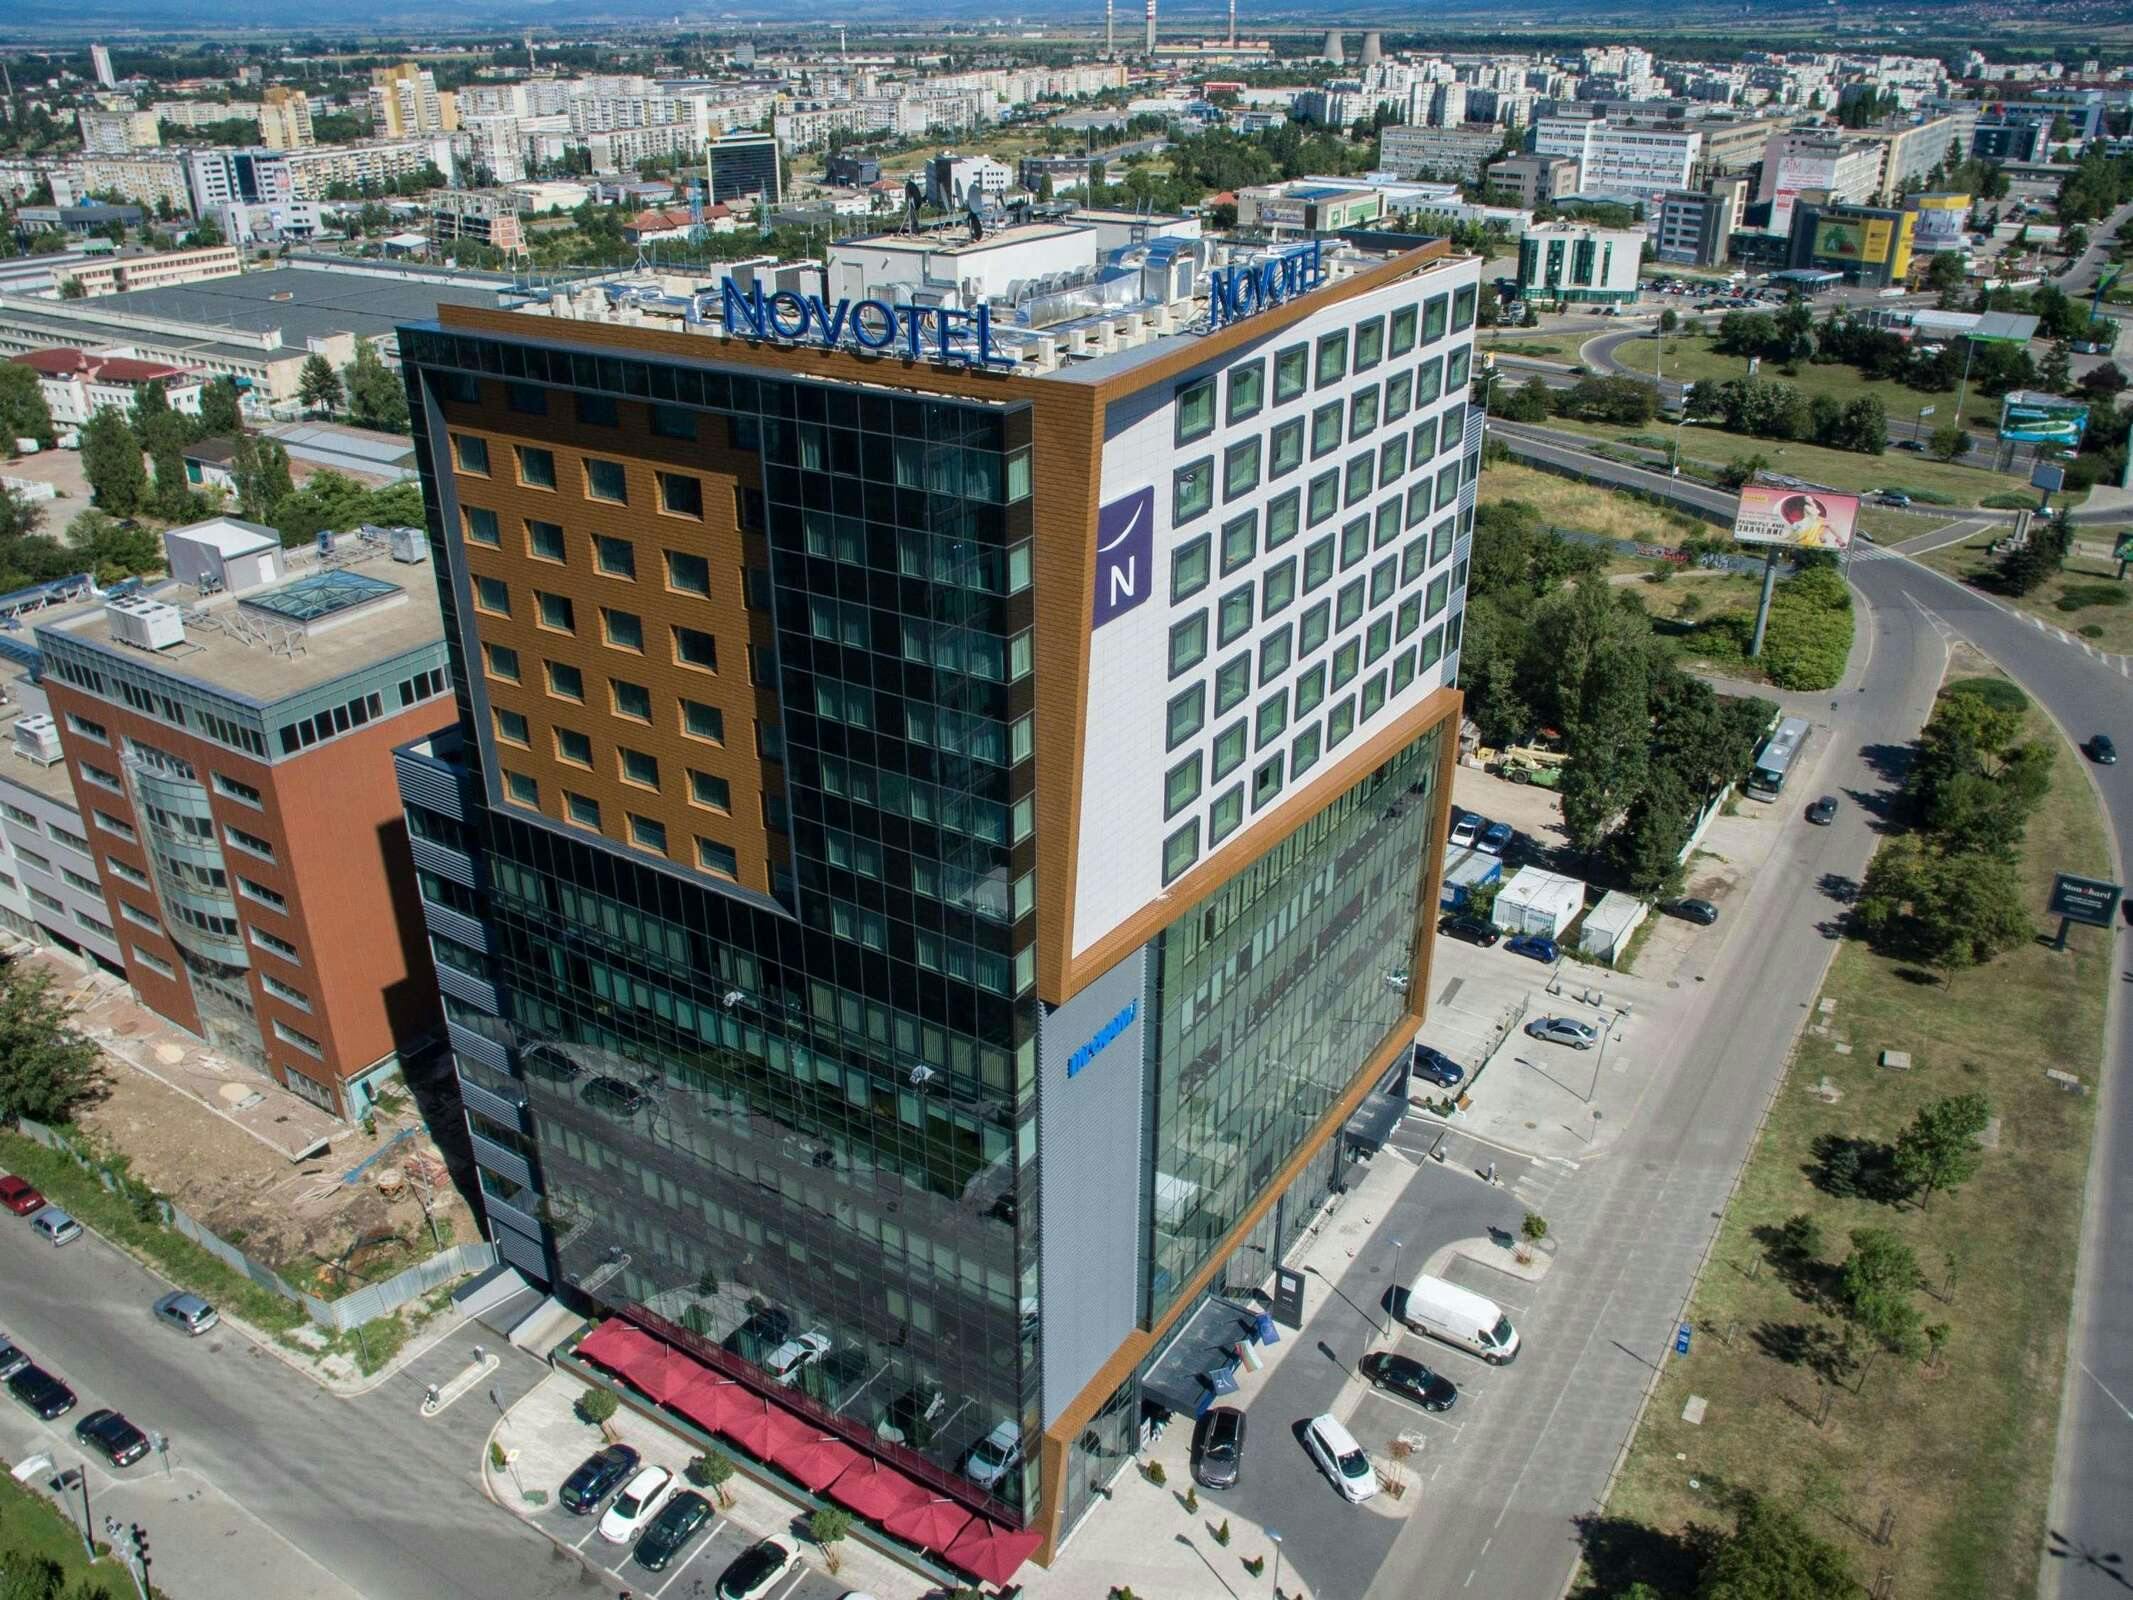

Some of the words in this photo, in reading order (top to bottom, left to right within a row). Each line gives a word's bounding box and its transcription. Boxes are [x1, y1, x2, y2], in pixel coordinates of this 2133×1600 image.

[720, 275, 1017, 368] NOVOTEL
[1210, 239, 1329, 327] NOVOTEL
[1110, 555, 1135, 607] N
